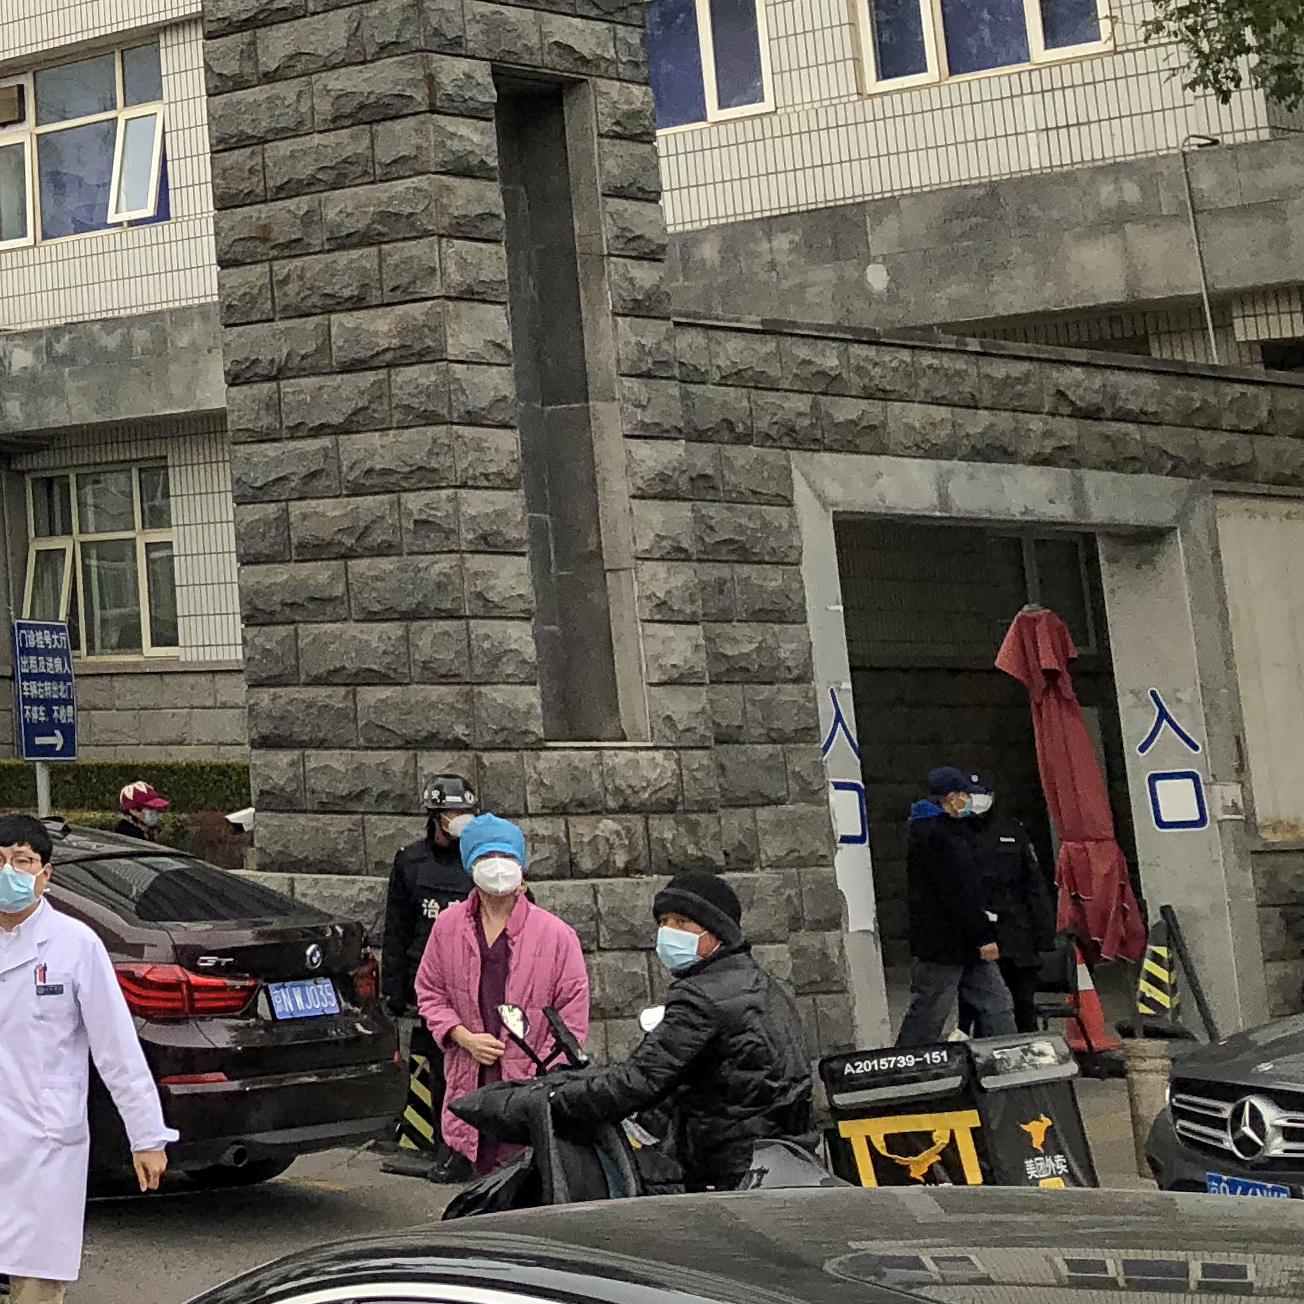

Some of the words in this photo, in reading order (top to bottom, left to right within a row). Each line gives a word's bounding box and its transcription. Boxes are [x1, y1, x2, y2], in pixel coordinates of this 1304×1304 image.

[18, 630, 67, 649] 门诊挂号大厅
[20, 656, 71, 674] 出租及送病人
[1137, 688, 1209, 831] 入口
[843, 1050, 949, 1076] A2015739-151
[1024, 1154, 1069, 1179] 美团外卖
